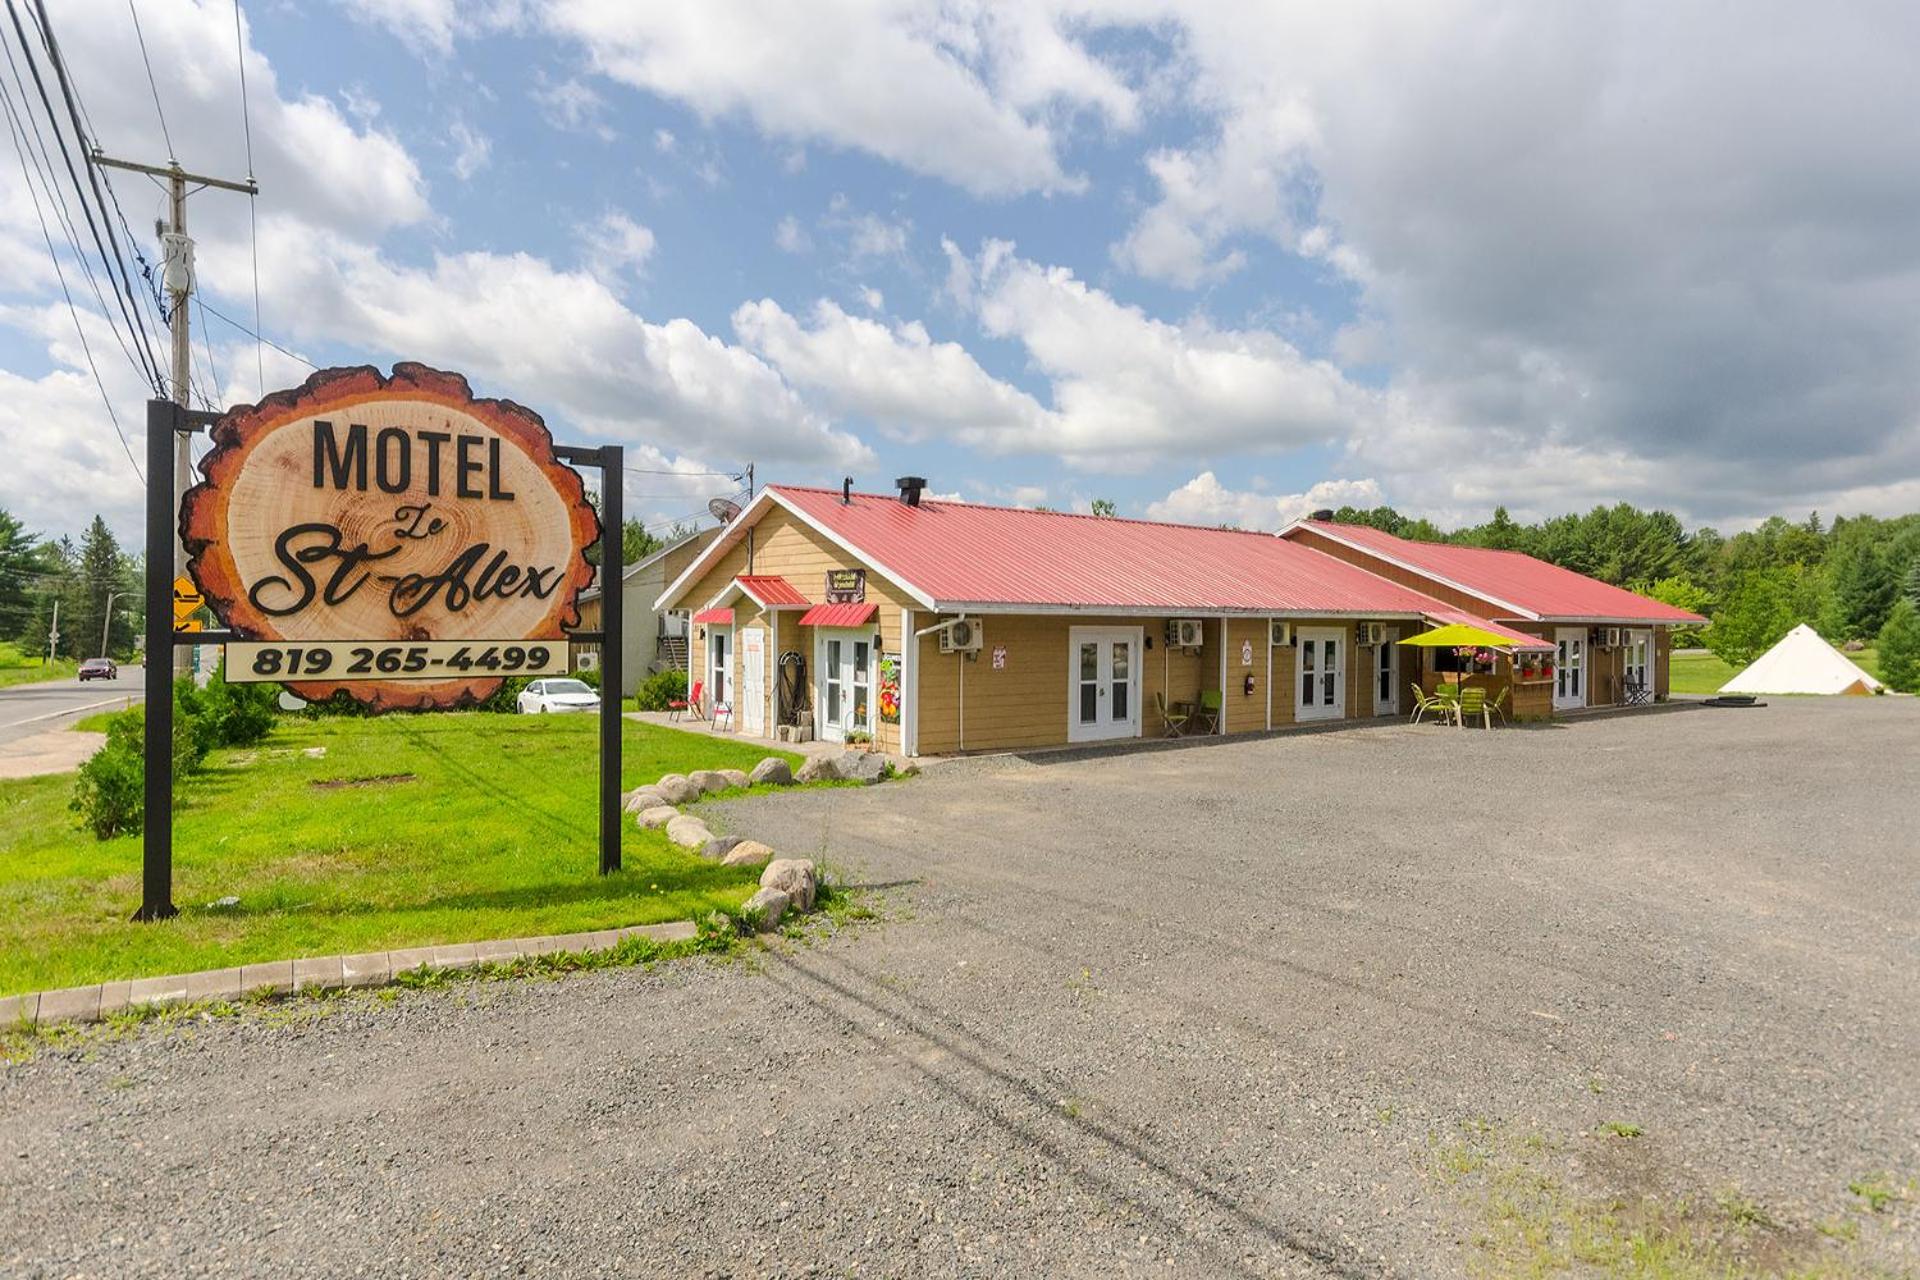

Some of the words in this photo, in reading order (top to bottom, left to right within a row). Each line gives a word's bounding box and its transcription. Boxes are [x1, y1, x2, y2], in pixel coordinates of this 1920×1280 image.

[313, 420, 515, 501] MOTEL
[395, 502, 449, 539] Le
[252, 648, 333, 675] 819
[346, 646, 550, 674] 265-4499
